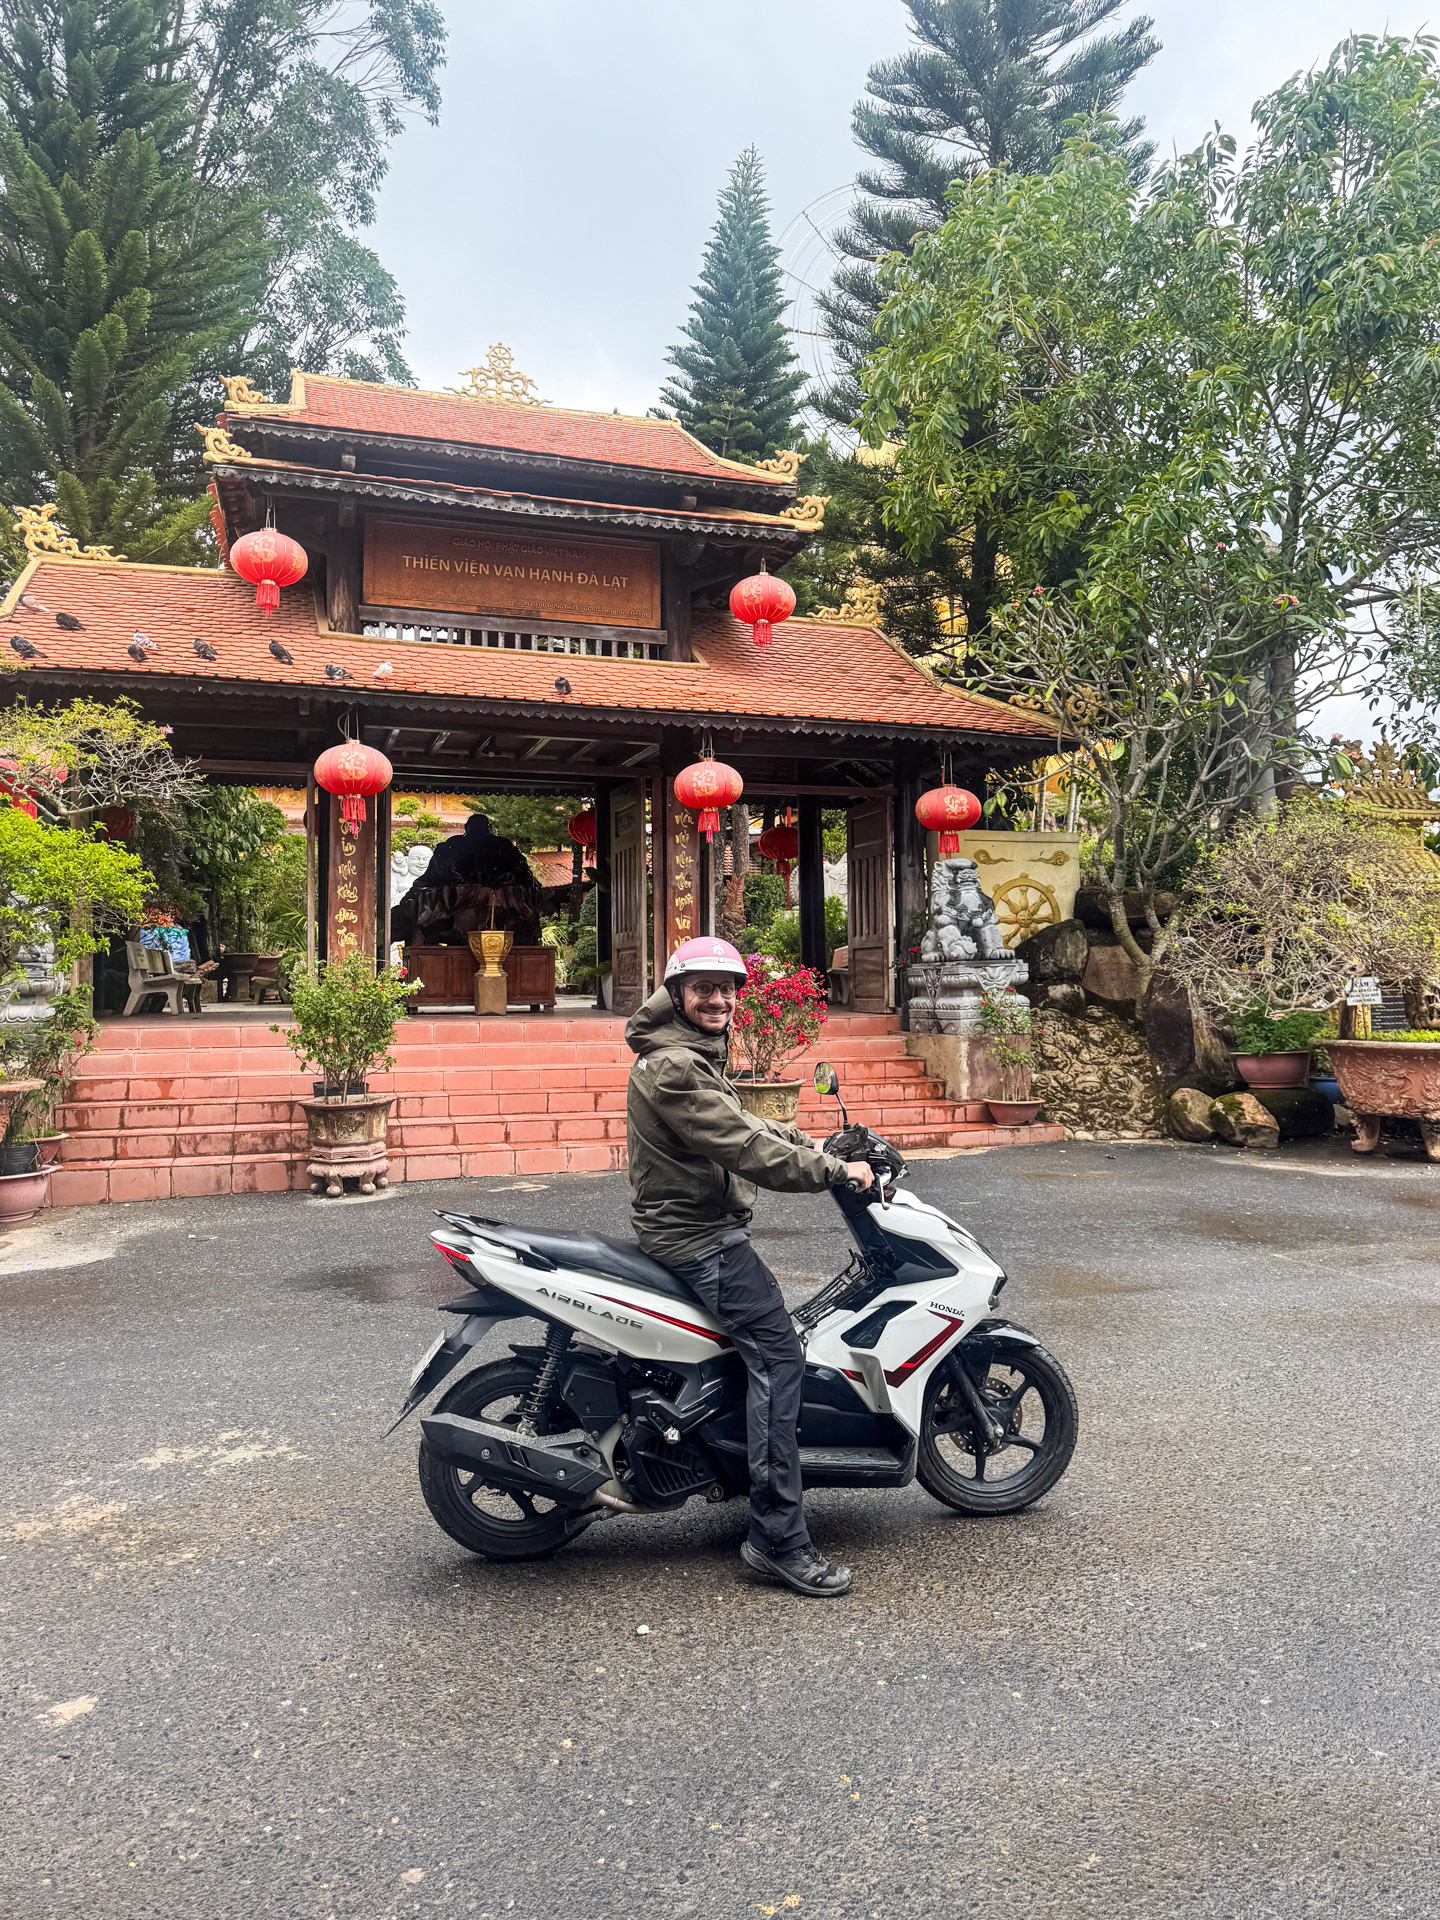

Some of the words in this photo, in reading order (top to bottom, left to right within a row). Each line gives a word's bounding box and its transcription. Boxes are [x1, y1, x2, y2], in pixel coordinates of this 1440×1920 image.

[565, 550, 586, 559] NAM
[493, 564, 525, 581] VẠN
[530, 567, 574, 584] HẠNH
[576, 571, 599, 586] ĐÀ
[603, 574, 629, 591] LẠT
[536, 1287, 644, 1329] AIRBLADE
[930, 1301, 965, 1316] HONDA
